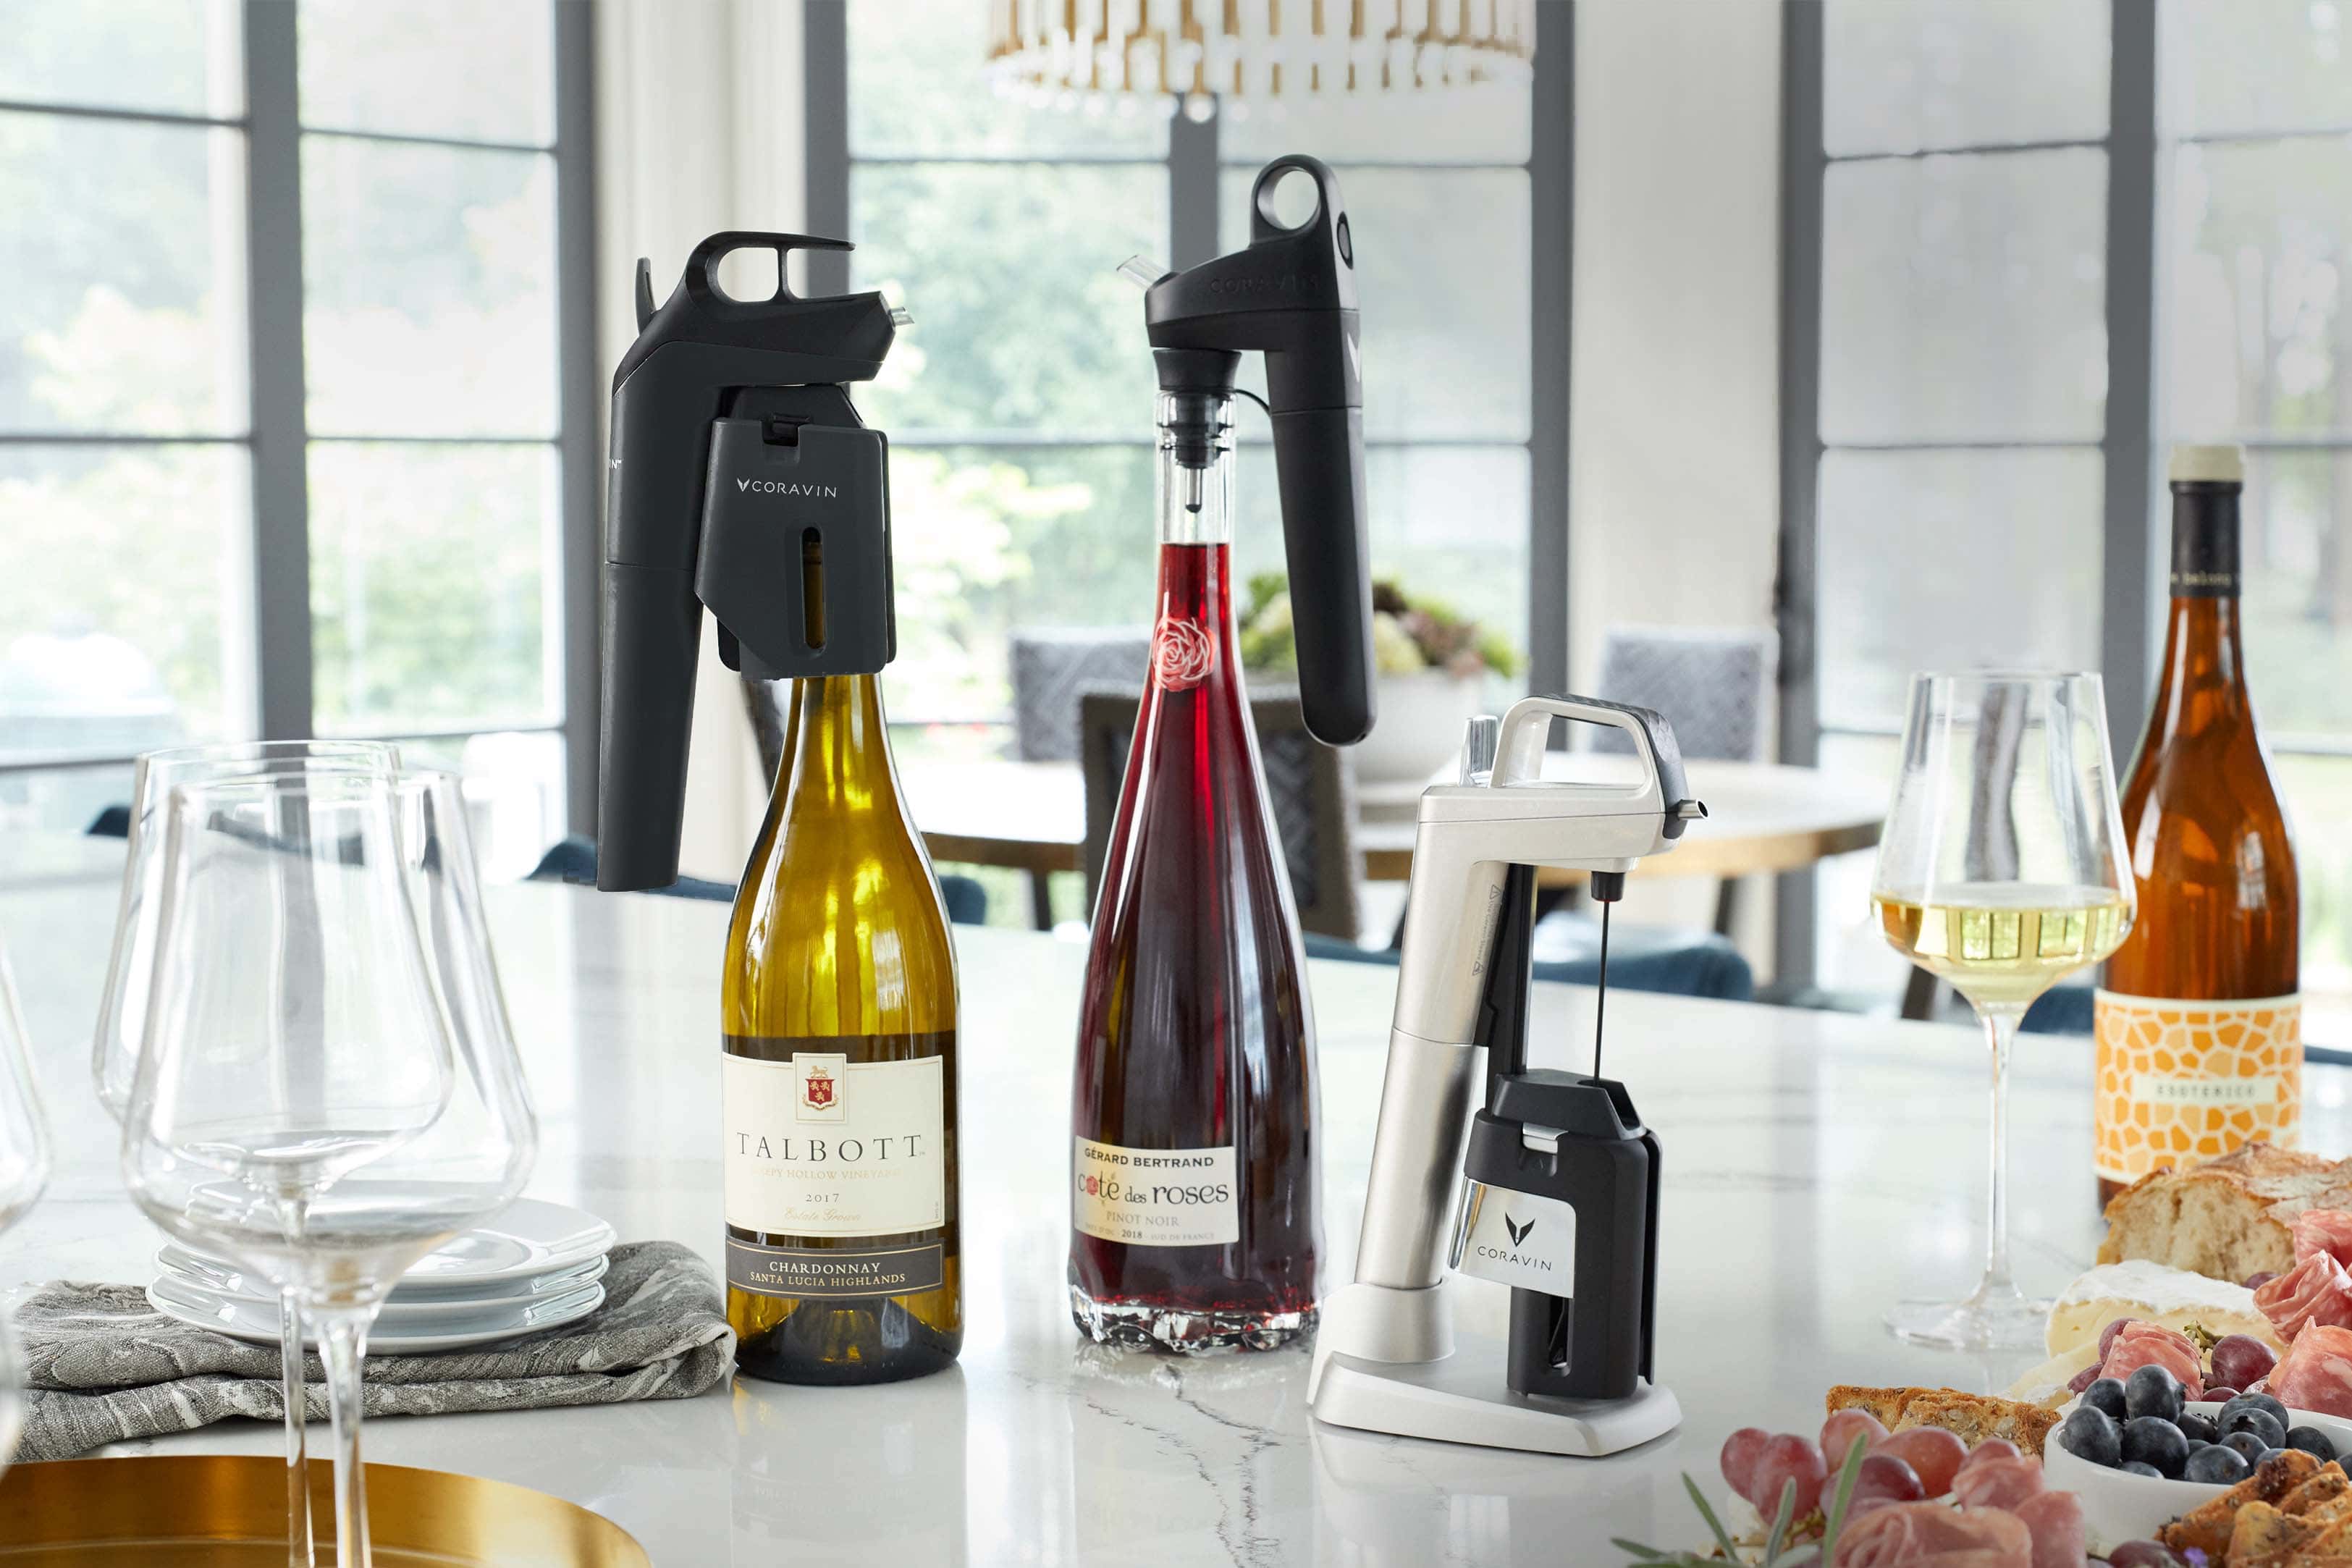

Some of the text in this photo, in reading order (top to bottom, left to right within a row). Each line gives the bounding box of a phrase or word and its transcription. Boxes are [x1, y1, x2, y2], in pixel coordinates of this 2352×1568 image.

[751, 480, 837, 498] CORAVIN
[736, 1132, 922, 1162] TALBOTT
[1084, 1147, 1214, 1168] GÉRARD BERTRAND
[787, 1169, 838, 1180] HOLLOW
[805, 1193, 840, 1203] 2017
[1124, 1186, 1147, 1204] des
[1152, 1184, 1229, 1205] roses
[1106, 1211, 1180, 1227] PINOT NOIR
[1121, 1228, 1142, 1239] 2018
[1478, 1246, 1552, 1271] CORAVIN
[770, 1261, 881, 1275] CHARDONNAY
[750, 1272, 906, 1286] SANTA LUCIA HIGHLANDS
